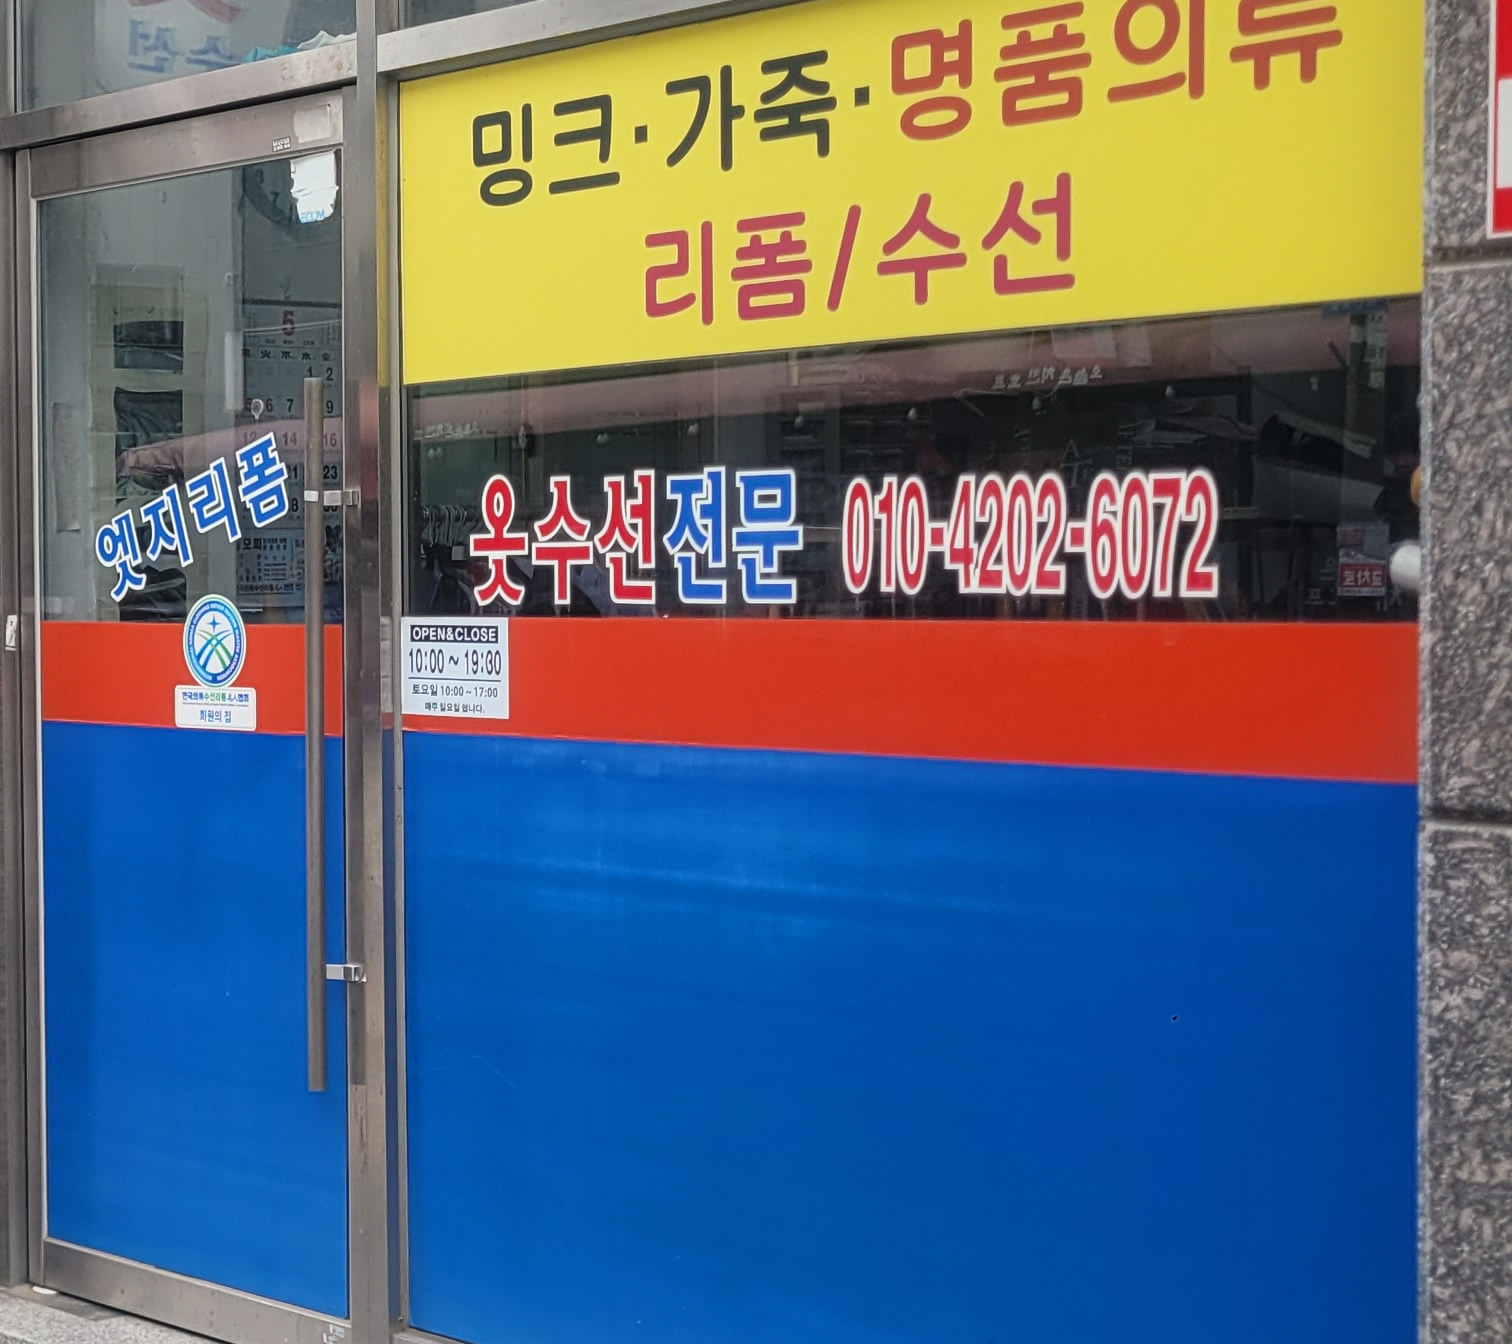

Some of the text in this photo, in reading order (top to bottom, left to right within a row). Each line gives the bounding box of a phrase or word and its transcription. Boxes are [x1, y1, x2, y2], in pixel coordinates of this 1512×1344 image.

[644, 172, 1076, 327] 리폼/수선
[326, 367, 334, 381] 2
[286, 398, 294, 413] 7
[326, 400, 334, 414] 9
[282, 432, 297, 446] 14
[323, 465, 338, 479] 23
[470, 466, 1218, 606] 옷수선전문 010-4202-6072
[412, 626, 497, 642] OPEN&CLOSE
[409, 648, 444, 674] 10:00
[464, 649, 502, 676] 19:30
[412, 684, 438, 697] 토요일
[441, 685, 464, 697] 10:00
[474, 686, 498, 698] 17:00
